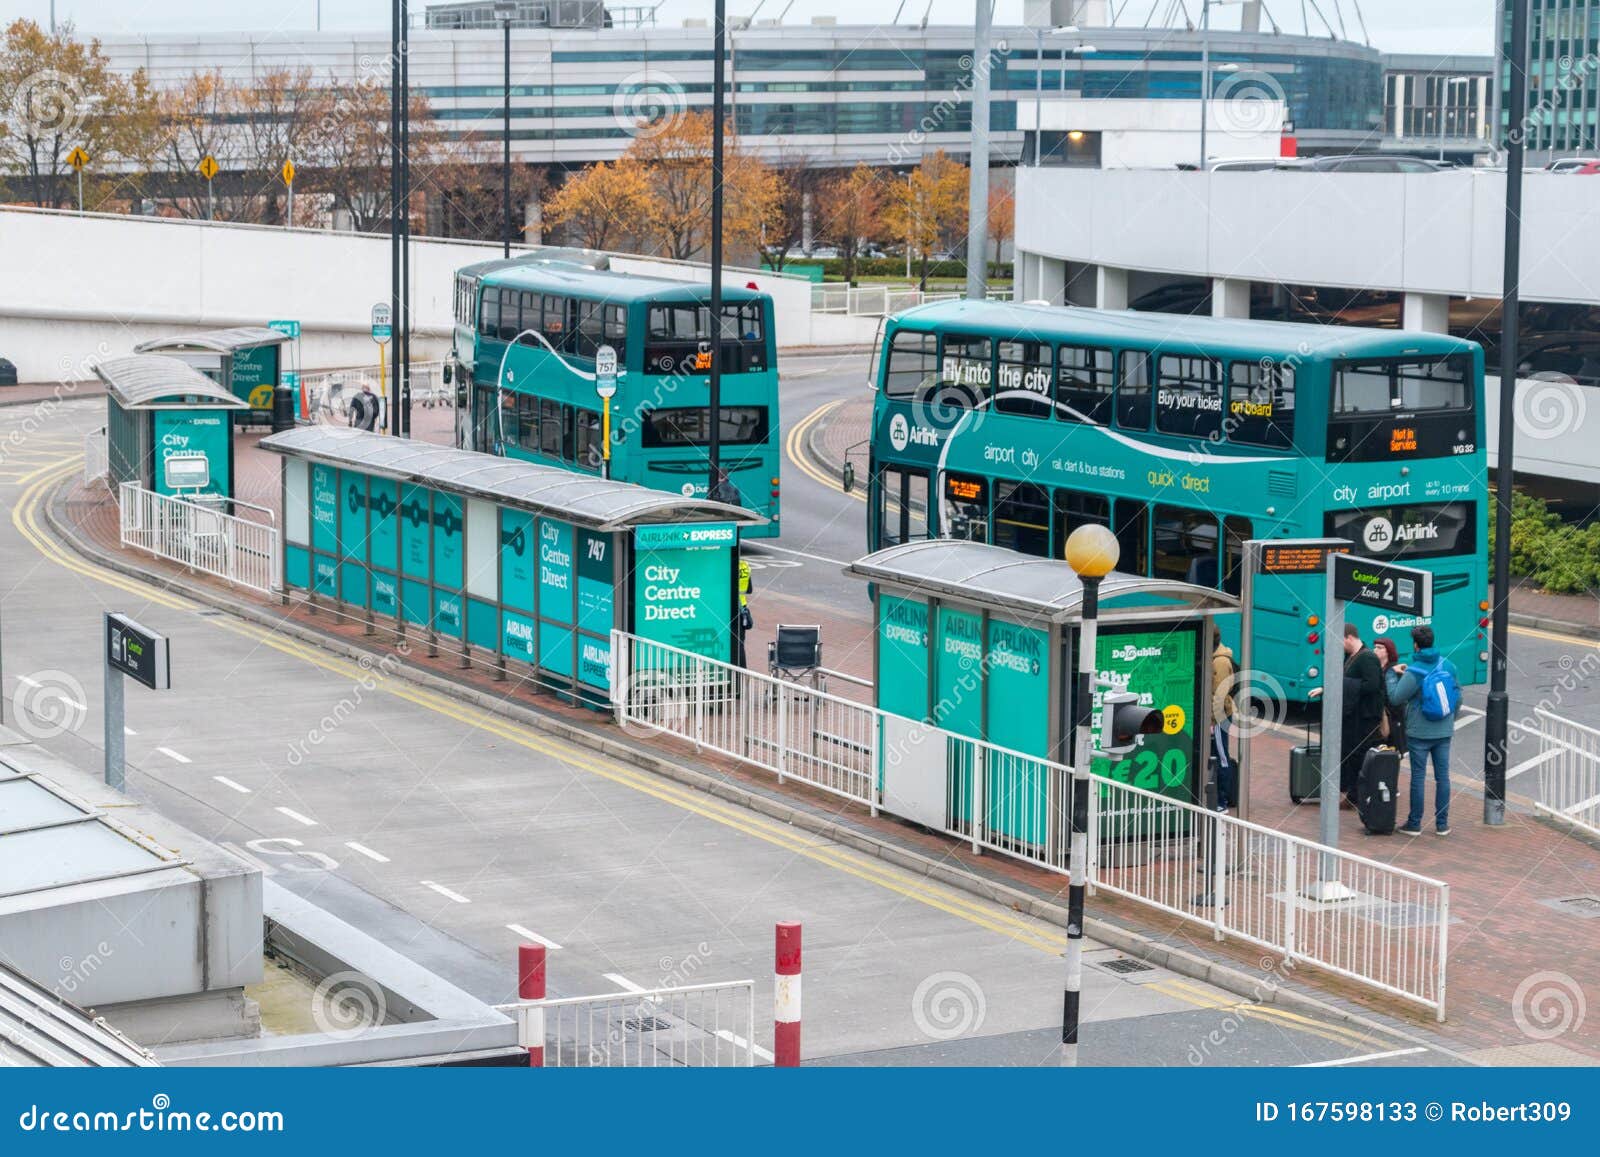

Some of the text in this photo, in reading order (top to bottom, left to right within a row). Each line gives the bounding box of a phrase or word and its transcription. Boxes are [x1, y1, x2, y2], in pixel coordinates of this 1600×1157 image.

[600, 362, 614, 372] 757
[942, 359, 1051, 395] Fly into the city
[1158, 390, 1273, 417] Buy your ticket on board
[162, 434, 189, 448] City
[909, 426, 939, 447] Airlink
[1393, 429, 1414, 440] Not in
[1390, 440, 1417, 452] Service
[1453, 444, 1474, 454] VG 32
[984, 442, 1015, 464] airport
[1021, 444, 1040, 470] city
[1079, 461, 1084, 473] &
[1085, 461, 1098, 475] bus
[314, 467, 327, 487] City
[1147, 468, 1210, 493] quick direct
[1333, 481, 1411, 503] city airport
[1441, 484, 1451, 495] 10
[541, 522, 560, 546] City
[690, 529, 733, 541] EXPRESS
[1394, 522, 1438, 541] Airlink
[541, 544, 570, 568] Centre
[587, 538, 606, 561] 747
[541, 566, 568, 590] Direct
[644, 565, 680, 584] City
[644, 585, 701, 601] Centre
[1382, 578, 1394, 601] 2
[644, 604, 696, 621] Direct
[1390, 618, 1416, 628] Dublin
[1416, 616, 1432, 626] Bus
[506, 619, 533, 641] AIRLINK
[886, 623, 921, 646] EXPRESS
[945, 616, 982, 638] AIRLIN
[945, 637, 982, 660] EXPRESS
[992, 628, 1041, 656] AIRLINK
[1167, 719, 1178, 729] €6
[1112, 748, 1188, 789] €20
